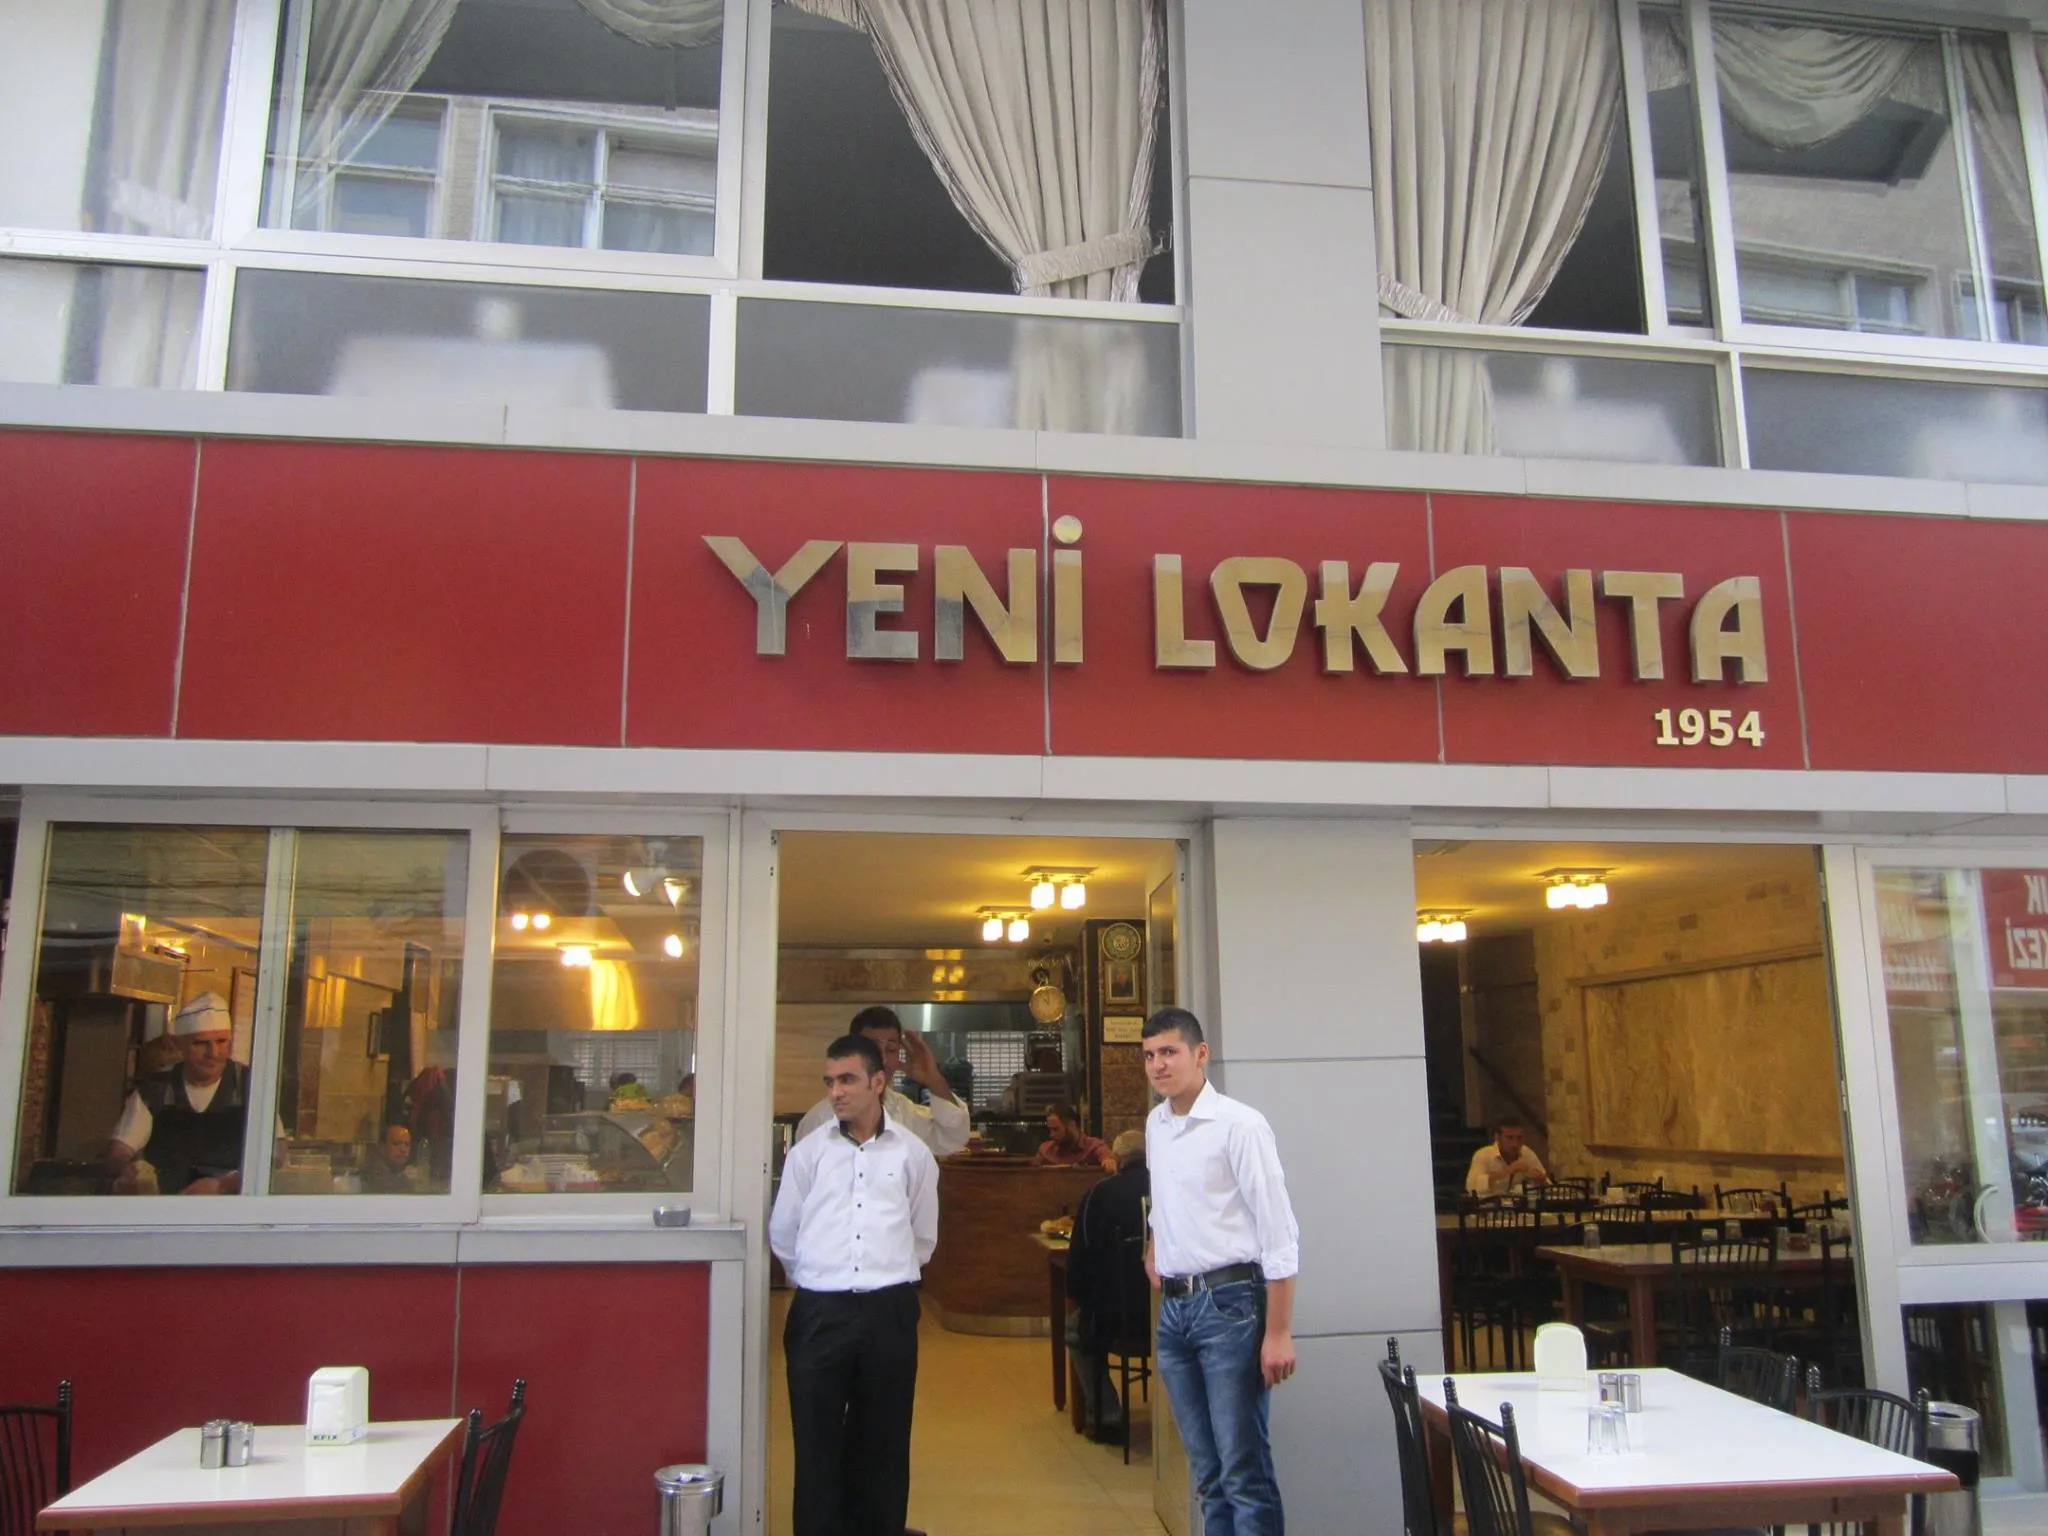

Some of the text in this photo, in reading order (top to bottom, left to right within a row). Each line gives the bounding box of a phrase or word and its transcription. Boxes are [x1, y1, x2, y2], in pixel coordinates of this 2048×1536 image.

[702, 515, 1769, 683] YENİ LOKANTA
[1655, 708, 1765, 747] 1954
